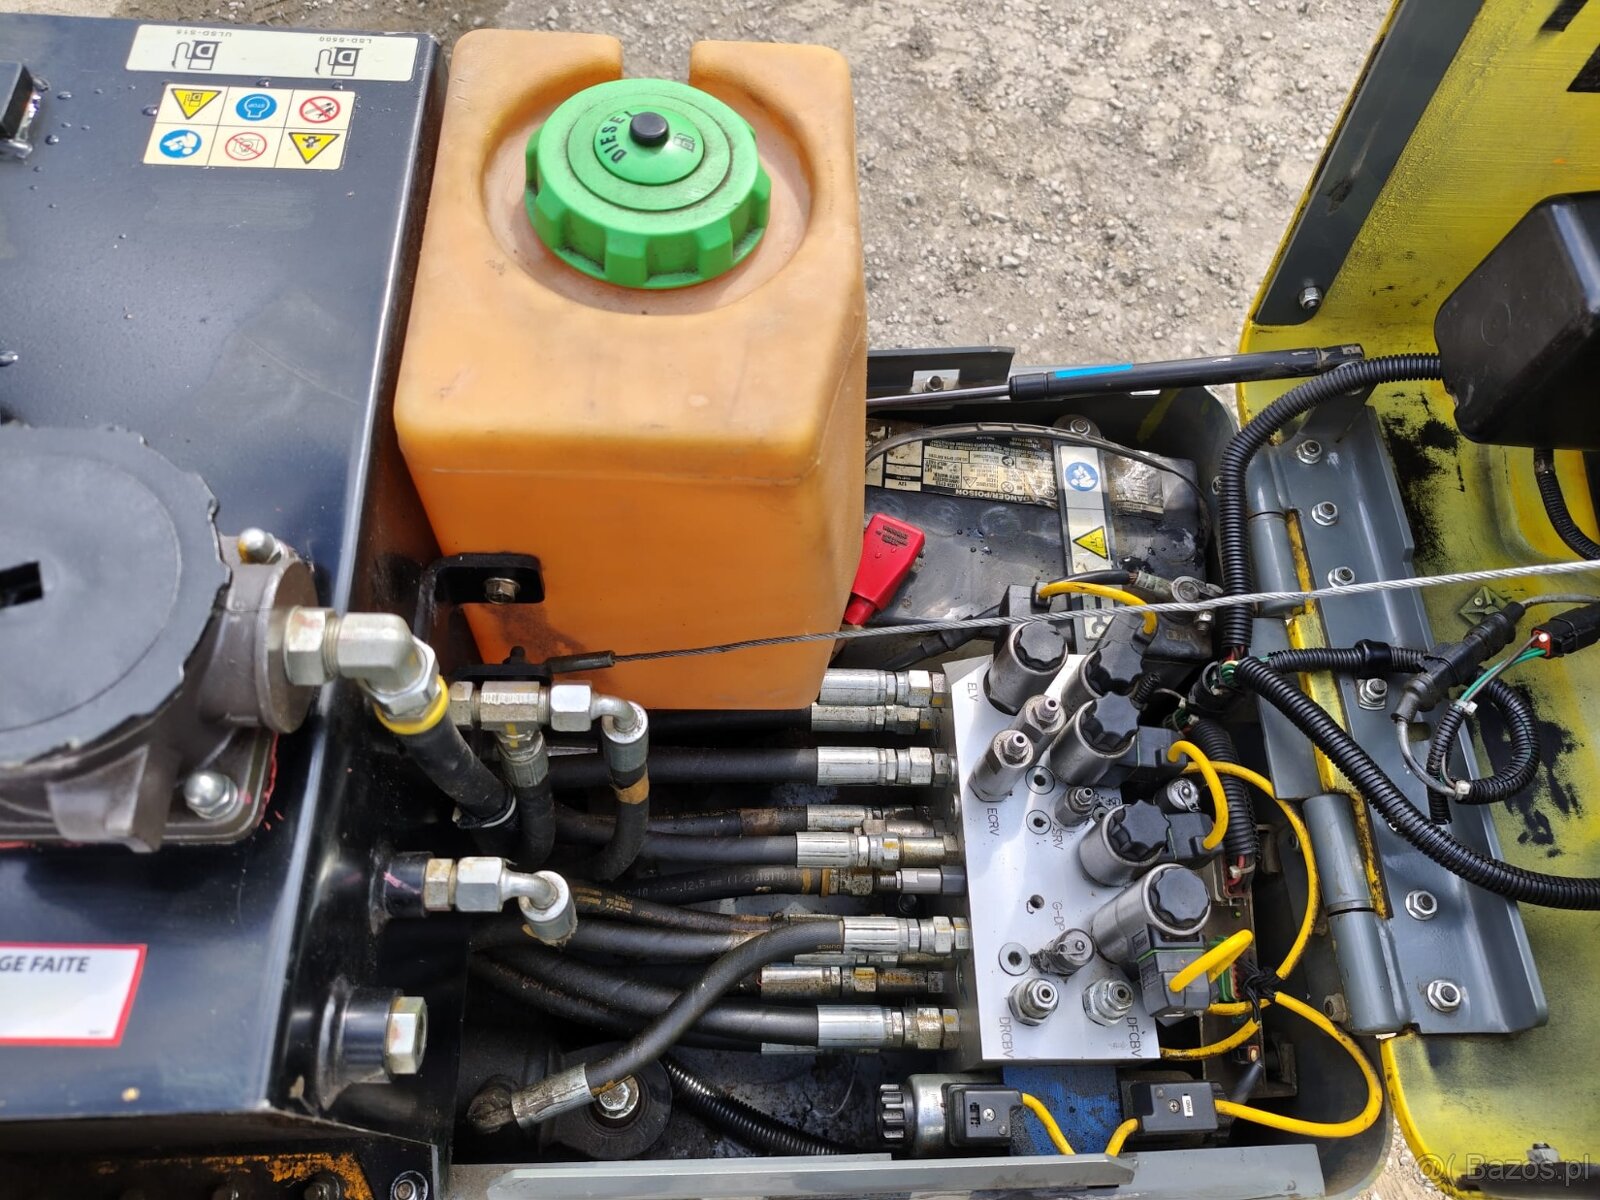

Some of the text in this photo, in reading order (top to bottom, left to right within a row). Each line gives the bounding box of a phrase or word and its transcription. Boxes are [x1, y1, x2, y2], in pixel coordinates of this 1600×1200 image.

[955, 489, 1030, 502] DANGER/POISON
[968, 682, 979, 702] ELV
[986, 807, 999, 836] ECRV
[29, 955, 91, 972] FAITE
[998, 1016, 1014, 1059] DRCBV
[1126, 1016, 1142, 1058] DFCBV
